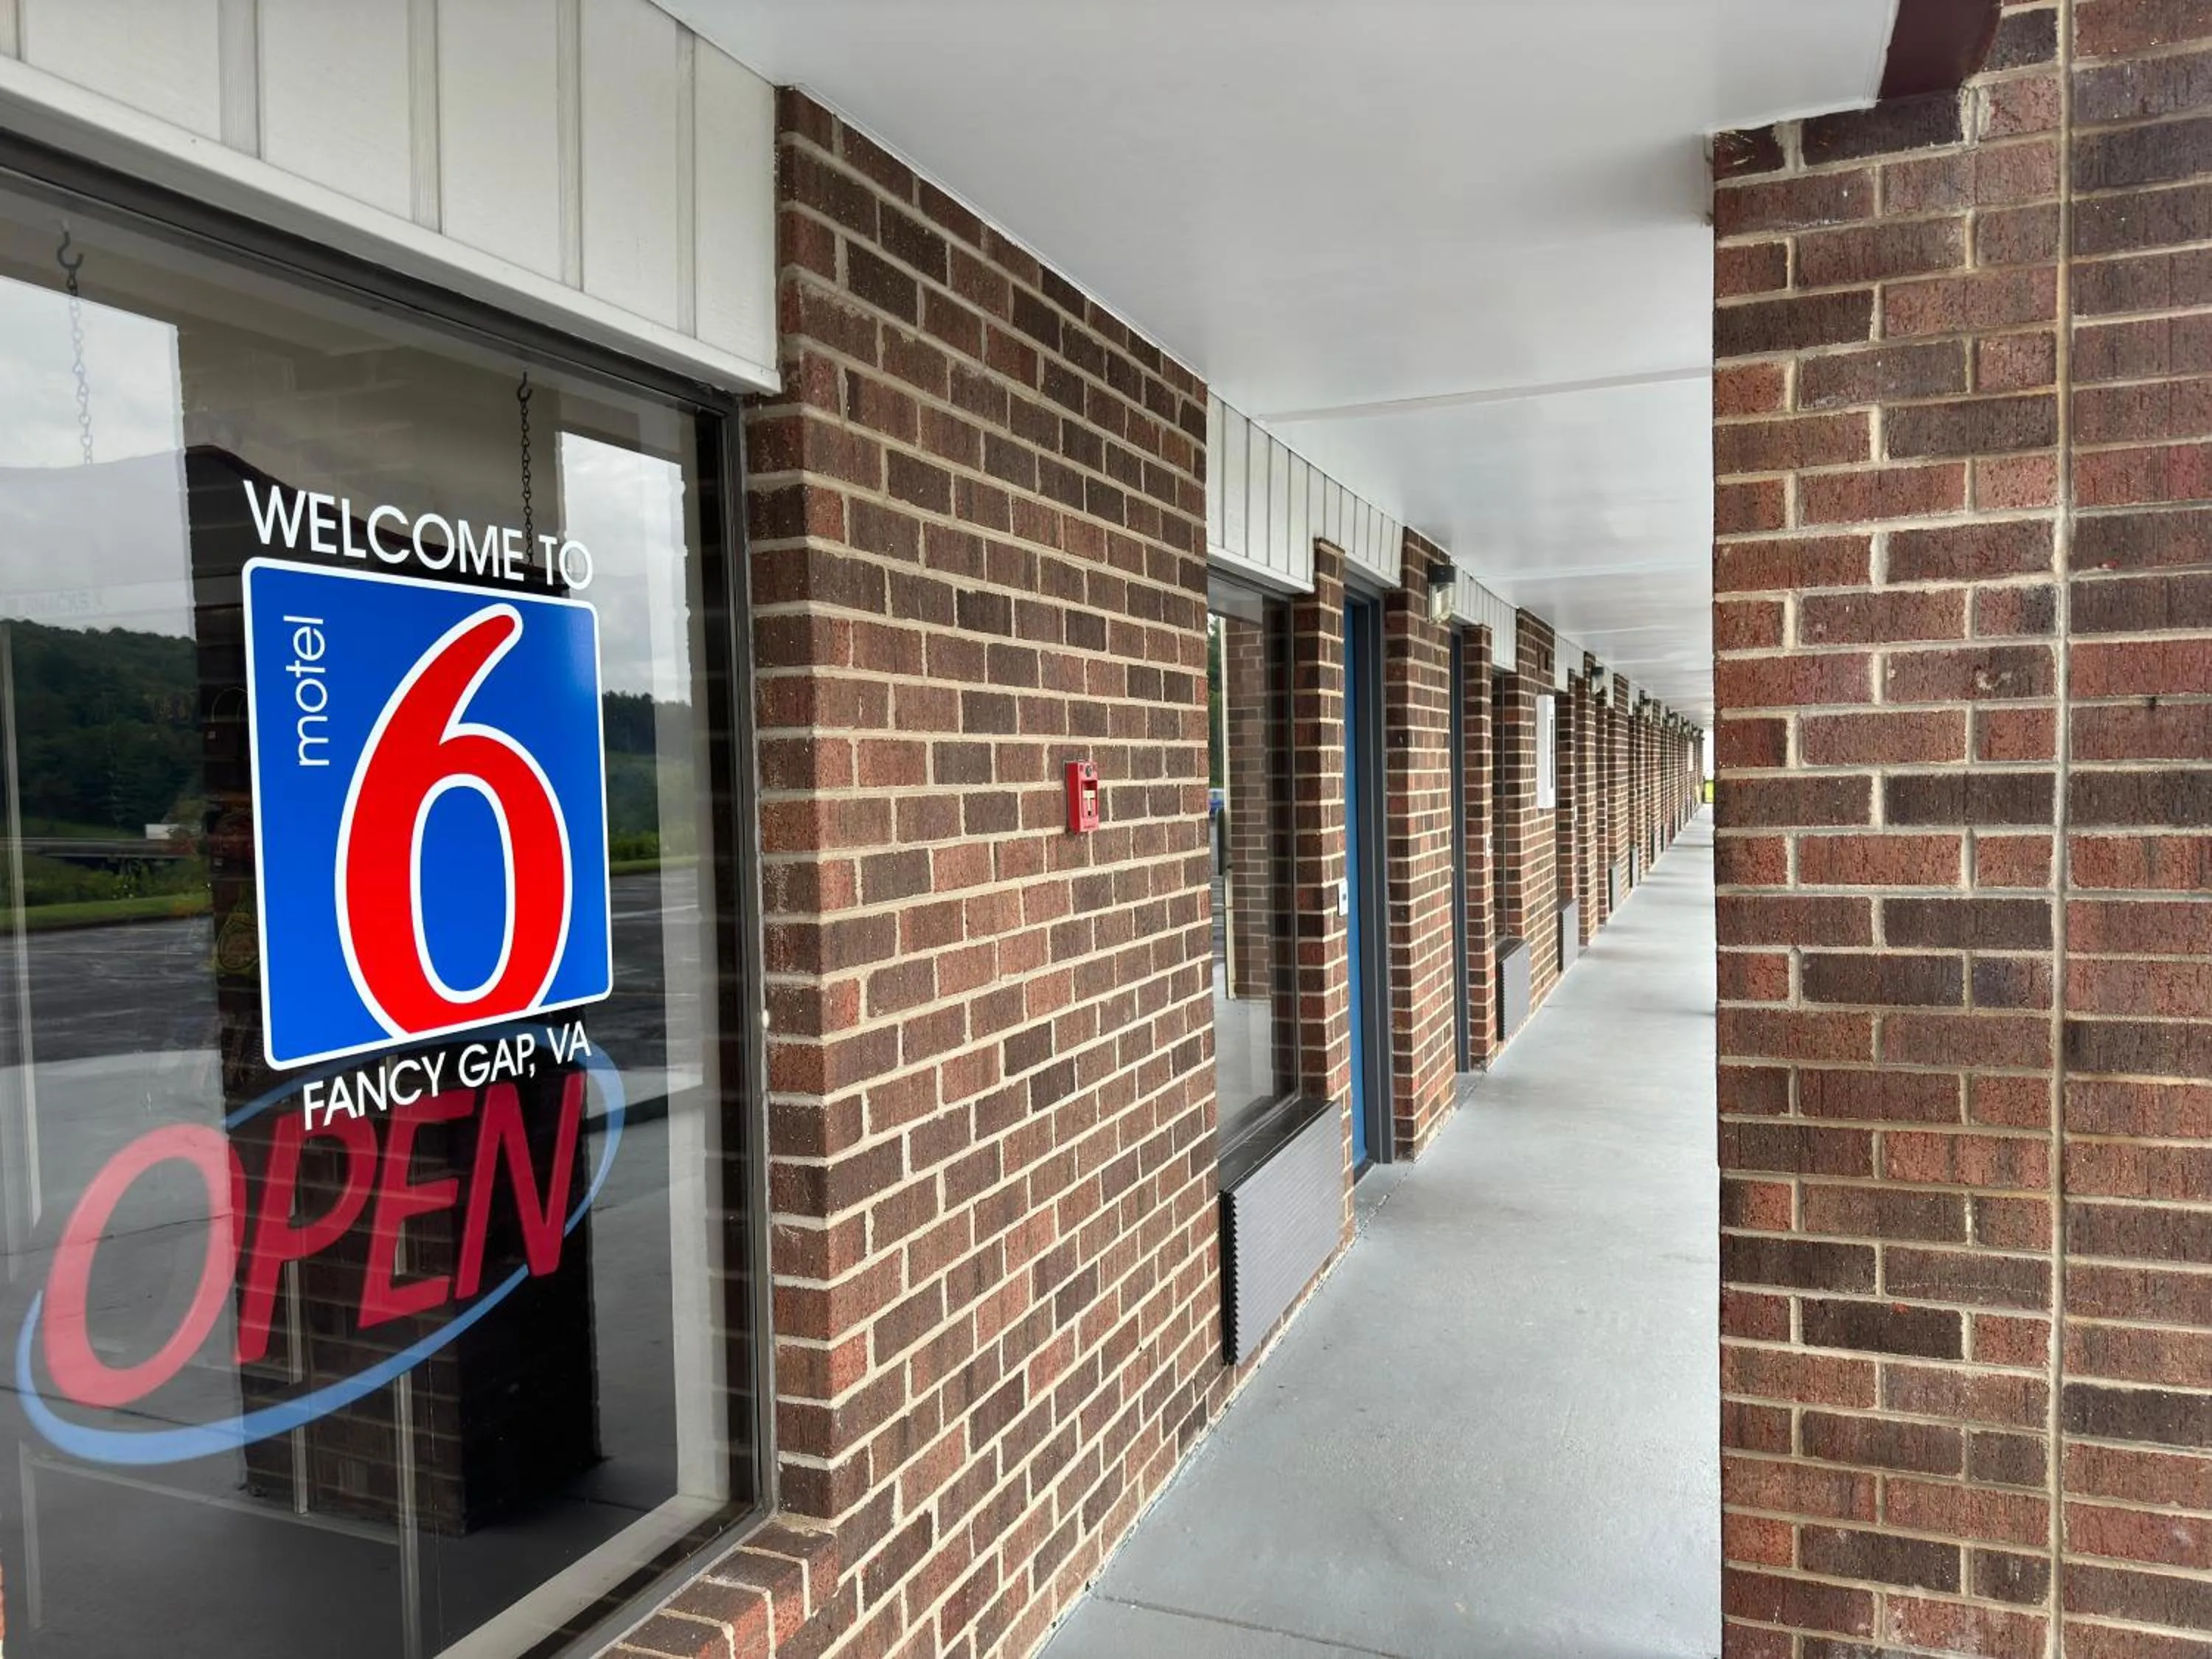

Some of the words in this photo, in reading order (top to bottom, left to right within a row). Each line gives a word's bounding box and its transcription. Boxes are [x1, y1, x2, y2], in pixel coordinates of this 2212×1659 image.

[243, 479, 524, 582] WELCOME
[539, 535, 593, 590] TO
[283, 615, 330, 767] motel
[335, 603, 572, 1037] 6
[303, 1052, 446, 1130] FANCY
[458, 1033, 536, 1088] GAP,
[546, 1020, 591, 1065] VA
[43, 1071, 586, 1409] OPEN
